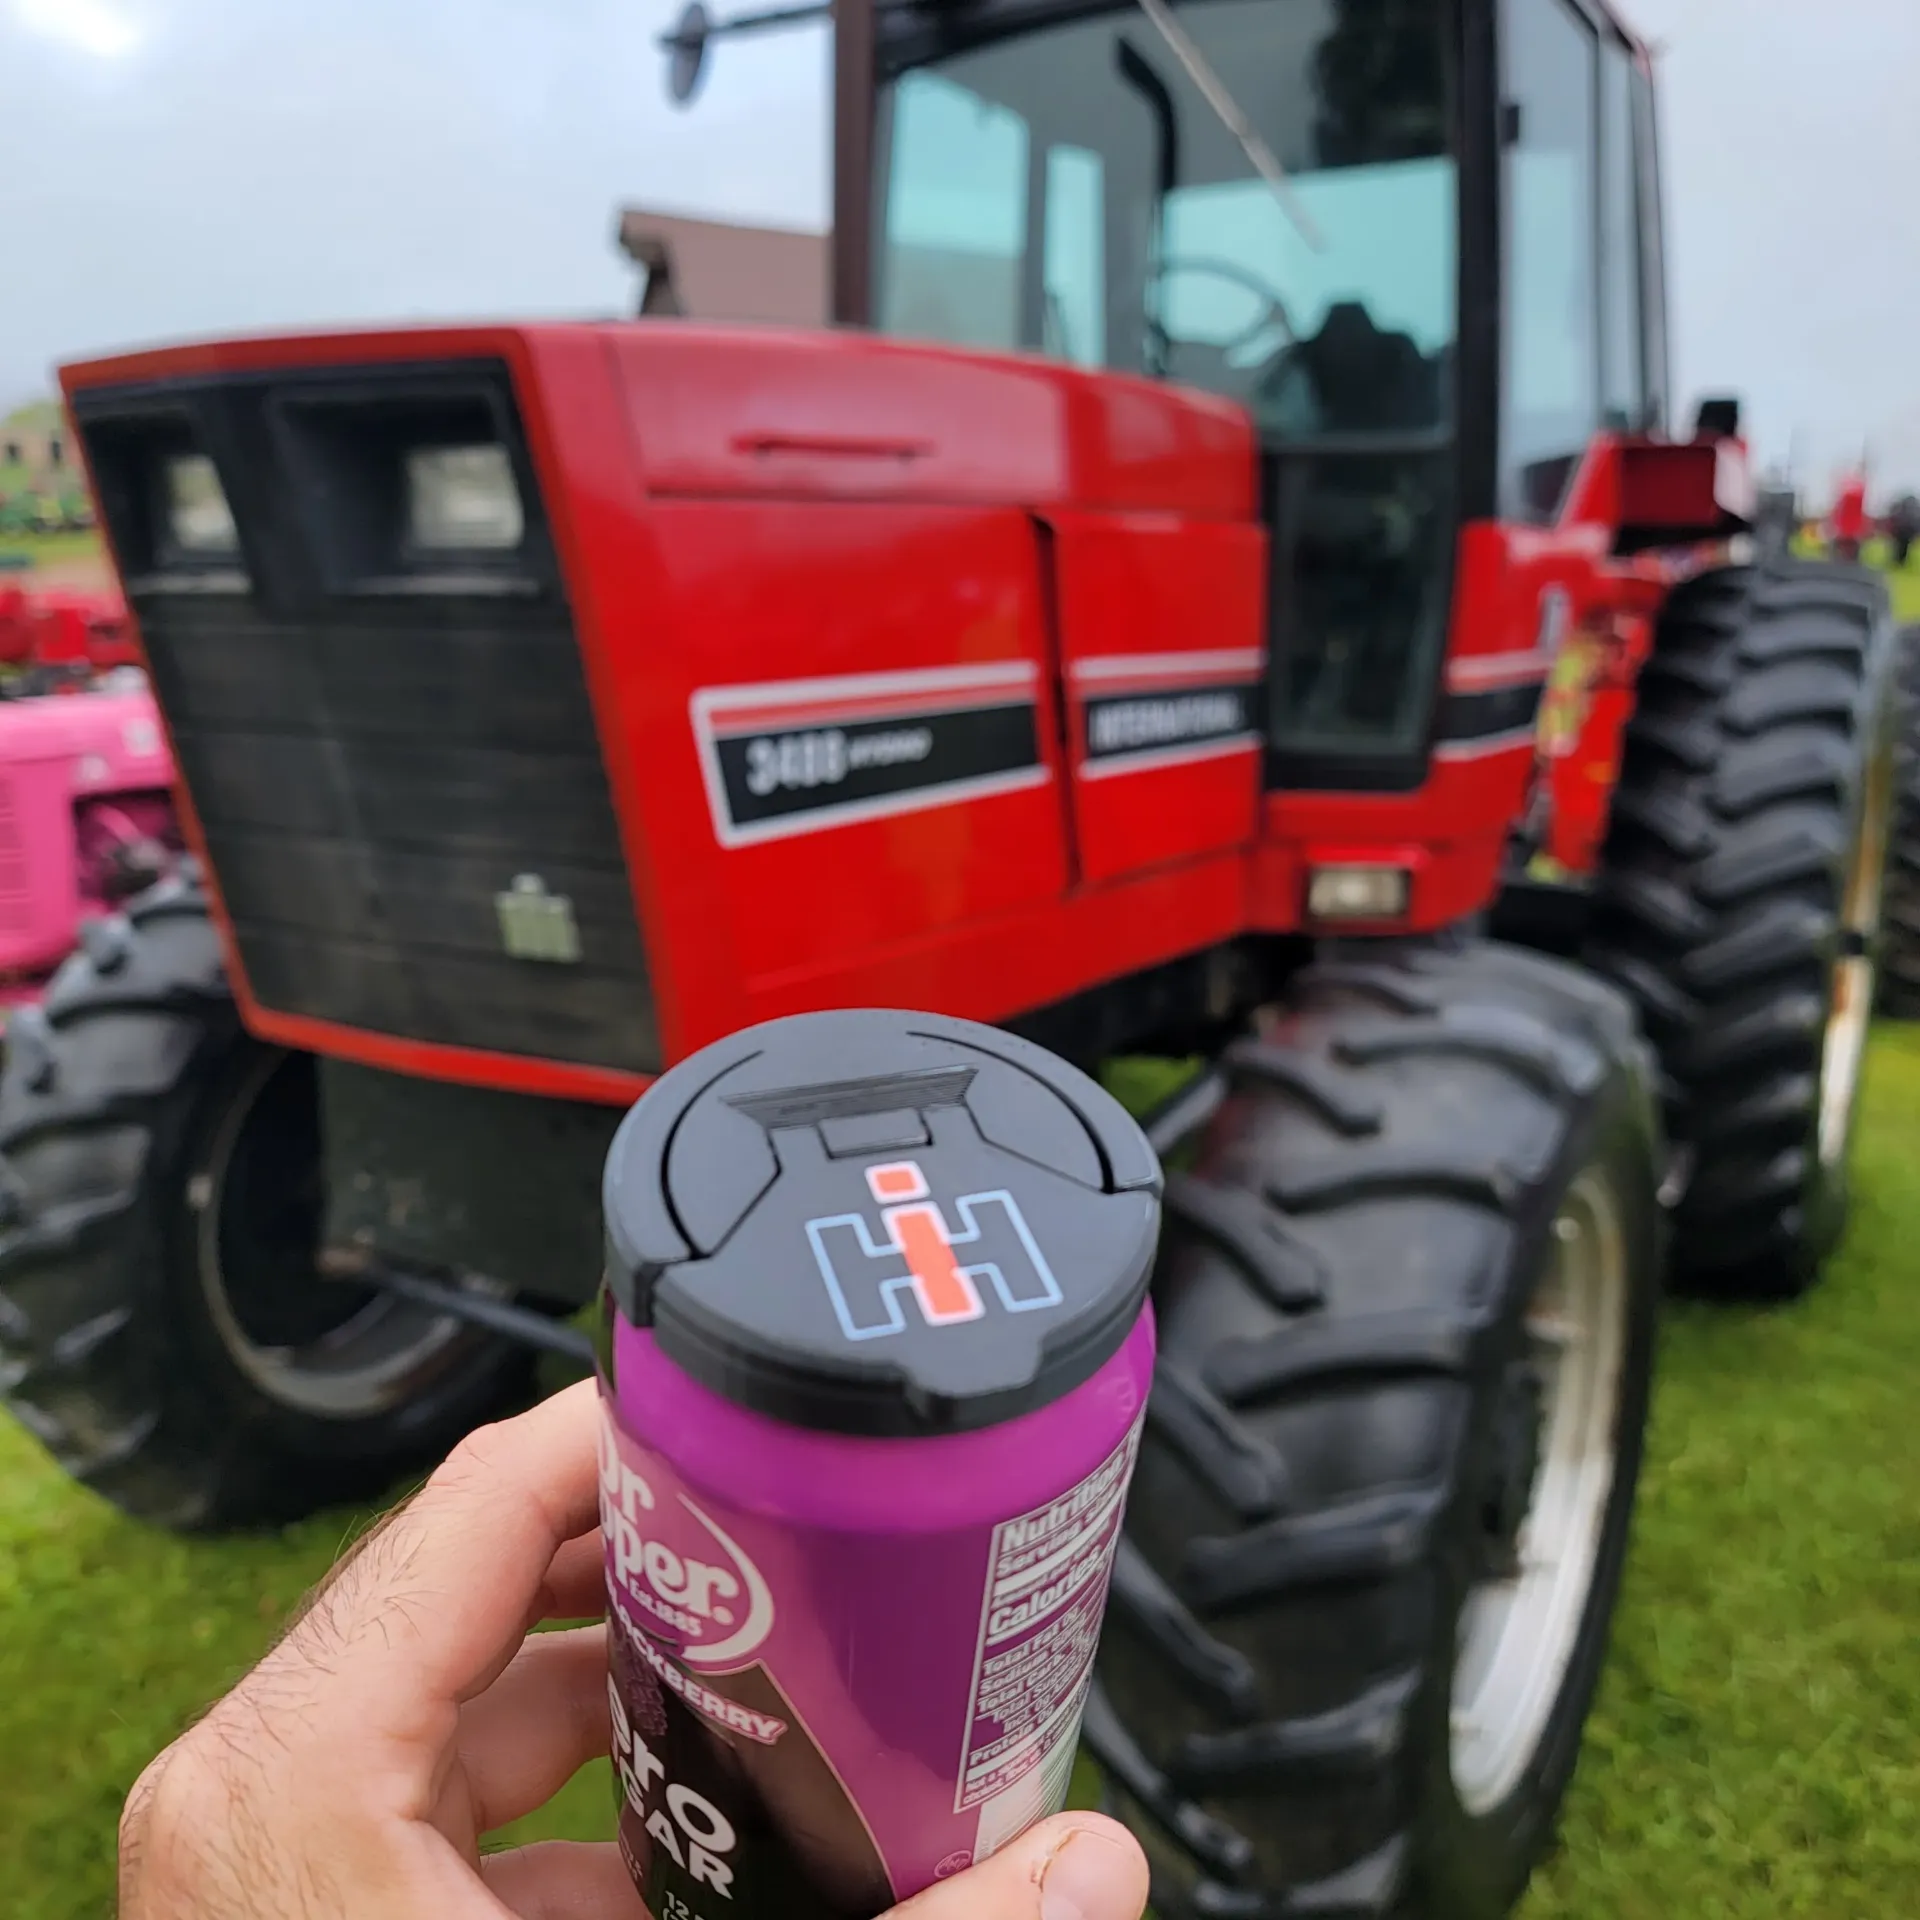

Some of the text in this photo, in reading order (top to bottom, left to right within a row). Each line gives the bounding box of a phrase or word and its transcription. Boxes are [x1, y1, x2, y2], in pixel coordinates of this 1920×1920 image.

[1001, 1450, 1123, 1554] Nutrition
[988, 1544, 1102, 1635] Calories
[984, 1640, 1031, 1677] Total
[978, 1681, 1025, 1713] Total
[970, 1721, 1036, 1766] Protein
